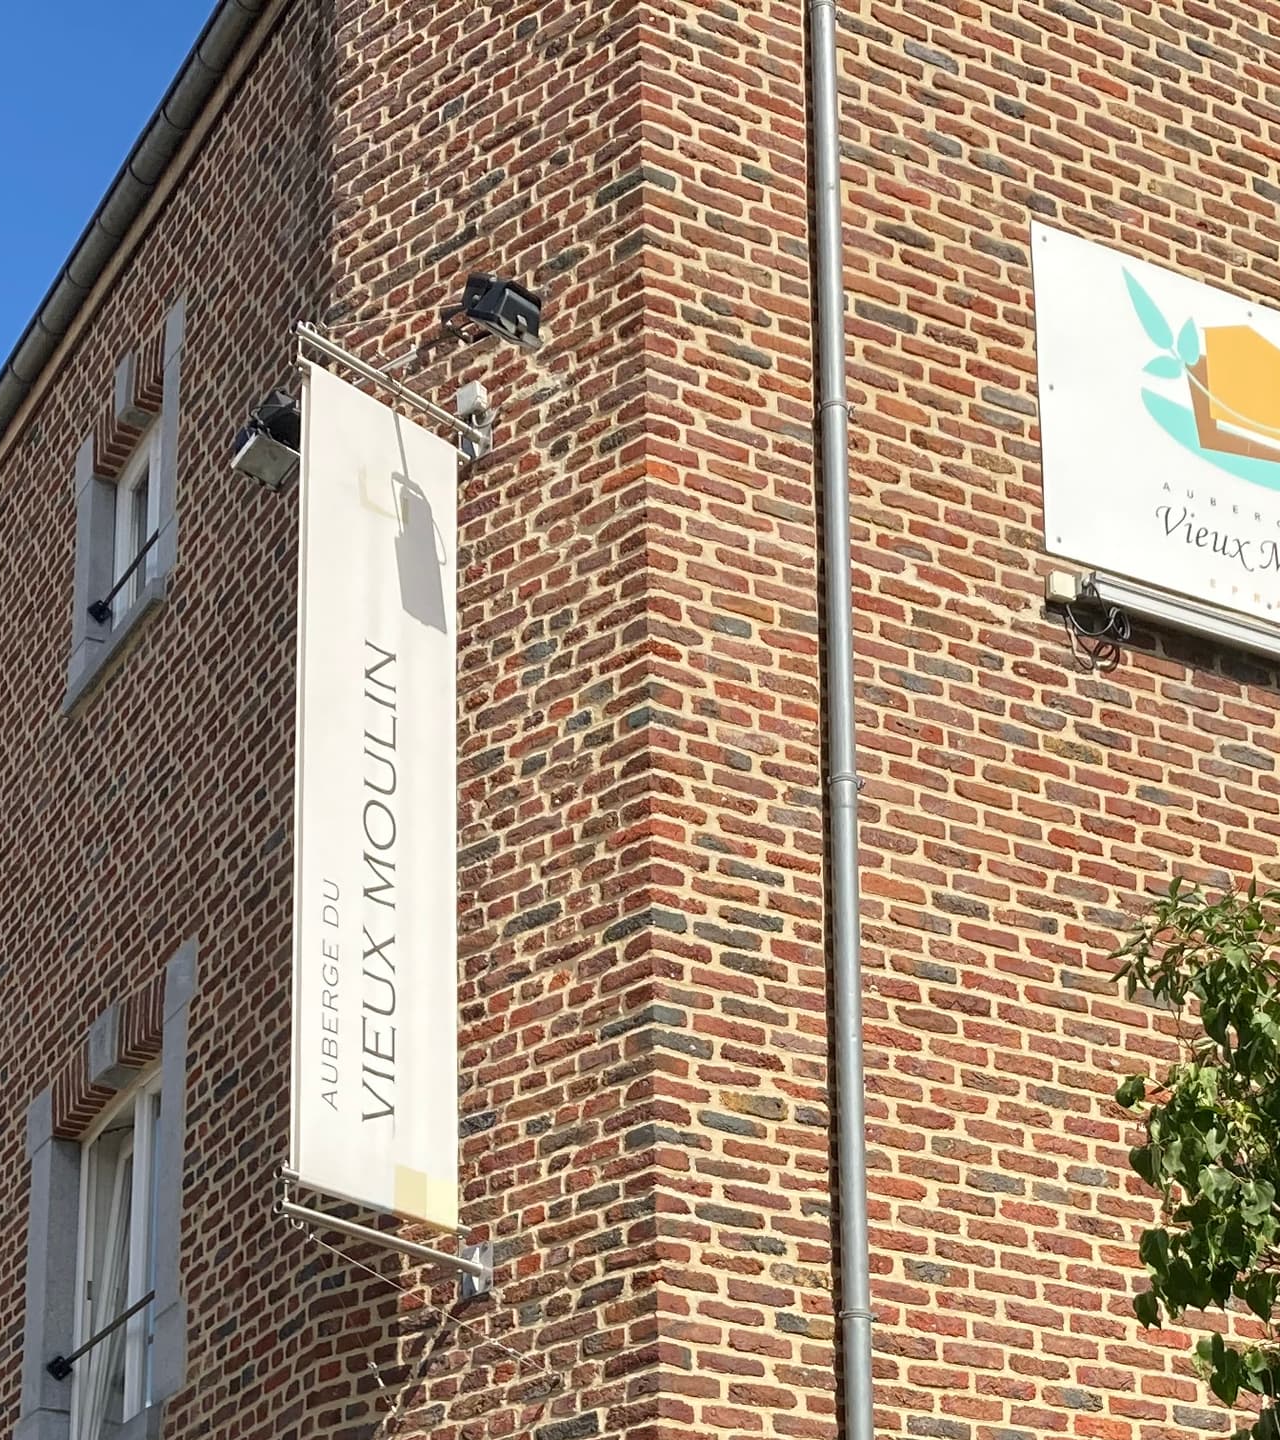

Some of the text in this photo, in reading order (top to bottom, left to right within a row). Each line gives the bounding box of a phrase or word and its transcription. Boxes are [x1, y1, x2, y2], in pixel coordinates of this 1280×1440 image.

[1155, 505, 1254, 573] Vieux
[321, 878, 340, 1112] AUBERGE DU
[361, 638, 398, 1123] VIEUX MOULIN
